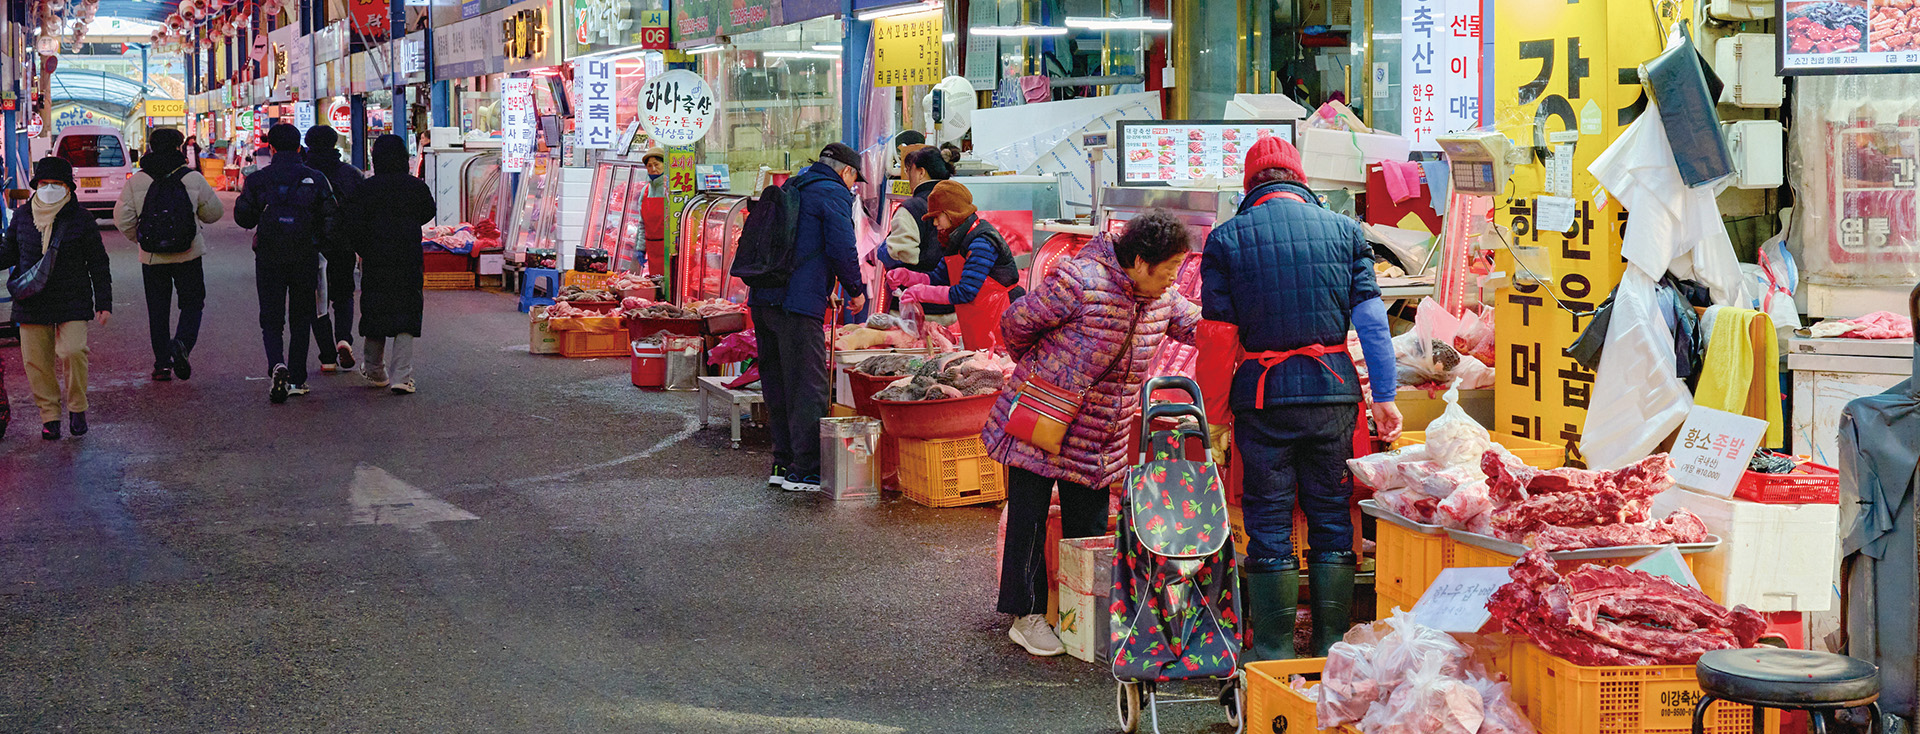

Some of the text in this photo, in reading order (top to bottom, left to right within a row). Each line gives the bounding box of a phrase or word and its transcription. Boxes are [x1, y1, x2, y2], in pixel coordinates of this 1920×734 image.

[649, 13, 661, 25] 서
[645, 29, 665, 43] 06
[1411, 0, 1434, 74] 축산
[645, 81, 711, 116] 하나축산
[1412, 84, 1434, 102] 한우
[152, 104, 165, 112] 512
[588, 60, 612, 145] 대호축산
[1412, 106, 1434, 124] 암소
[654, 127, 694, 140] 최상등급
[1892, 157, 1916, 188] 간
[1840, 217, 1890, 247] 염통
[1694, 455, 1719, 469] (국내산)
[1661, 690, 1701, 706] 이강축산
